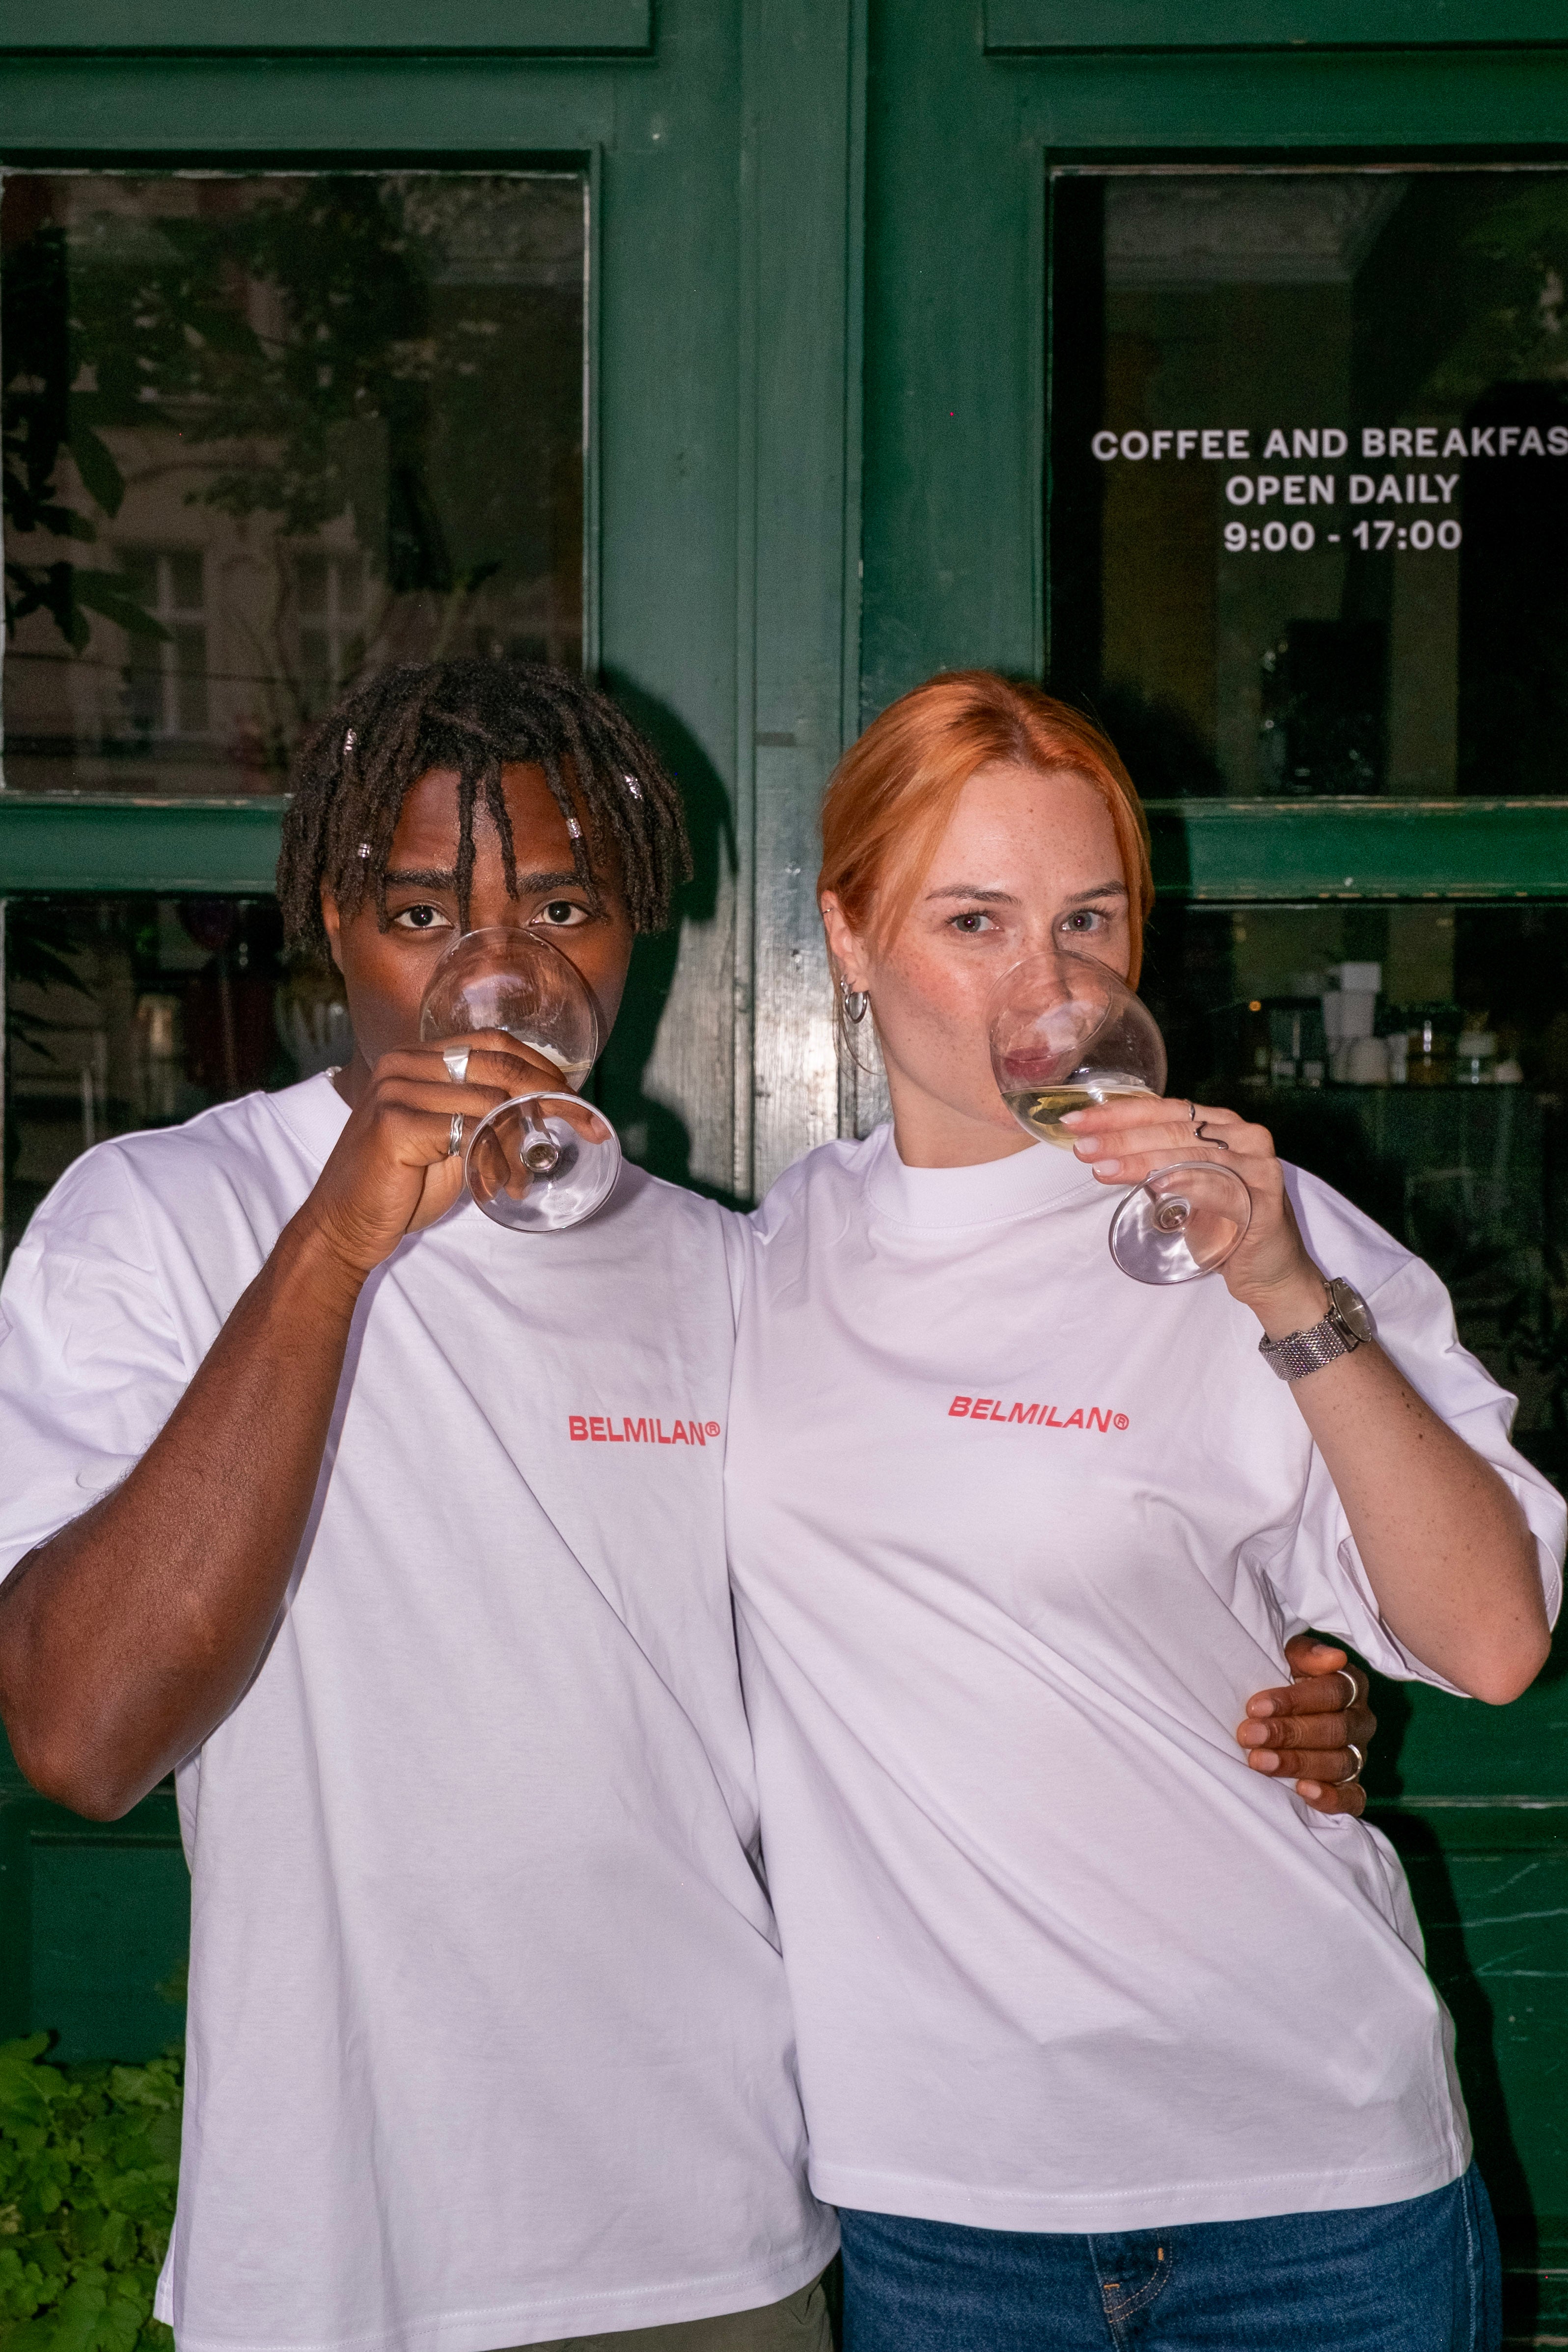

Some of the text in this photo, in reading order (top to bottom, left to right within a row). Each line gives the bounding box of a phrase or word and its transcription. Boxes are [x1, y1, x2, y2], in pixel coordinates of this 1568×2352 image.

[1091, 426, 1568, 461] COFFEE AND BREAKFAS
[1225, 474, 1459, 506] OPEN DAILY
[1223, 520, 1462, 552] 9:00 - 17:00
